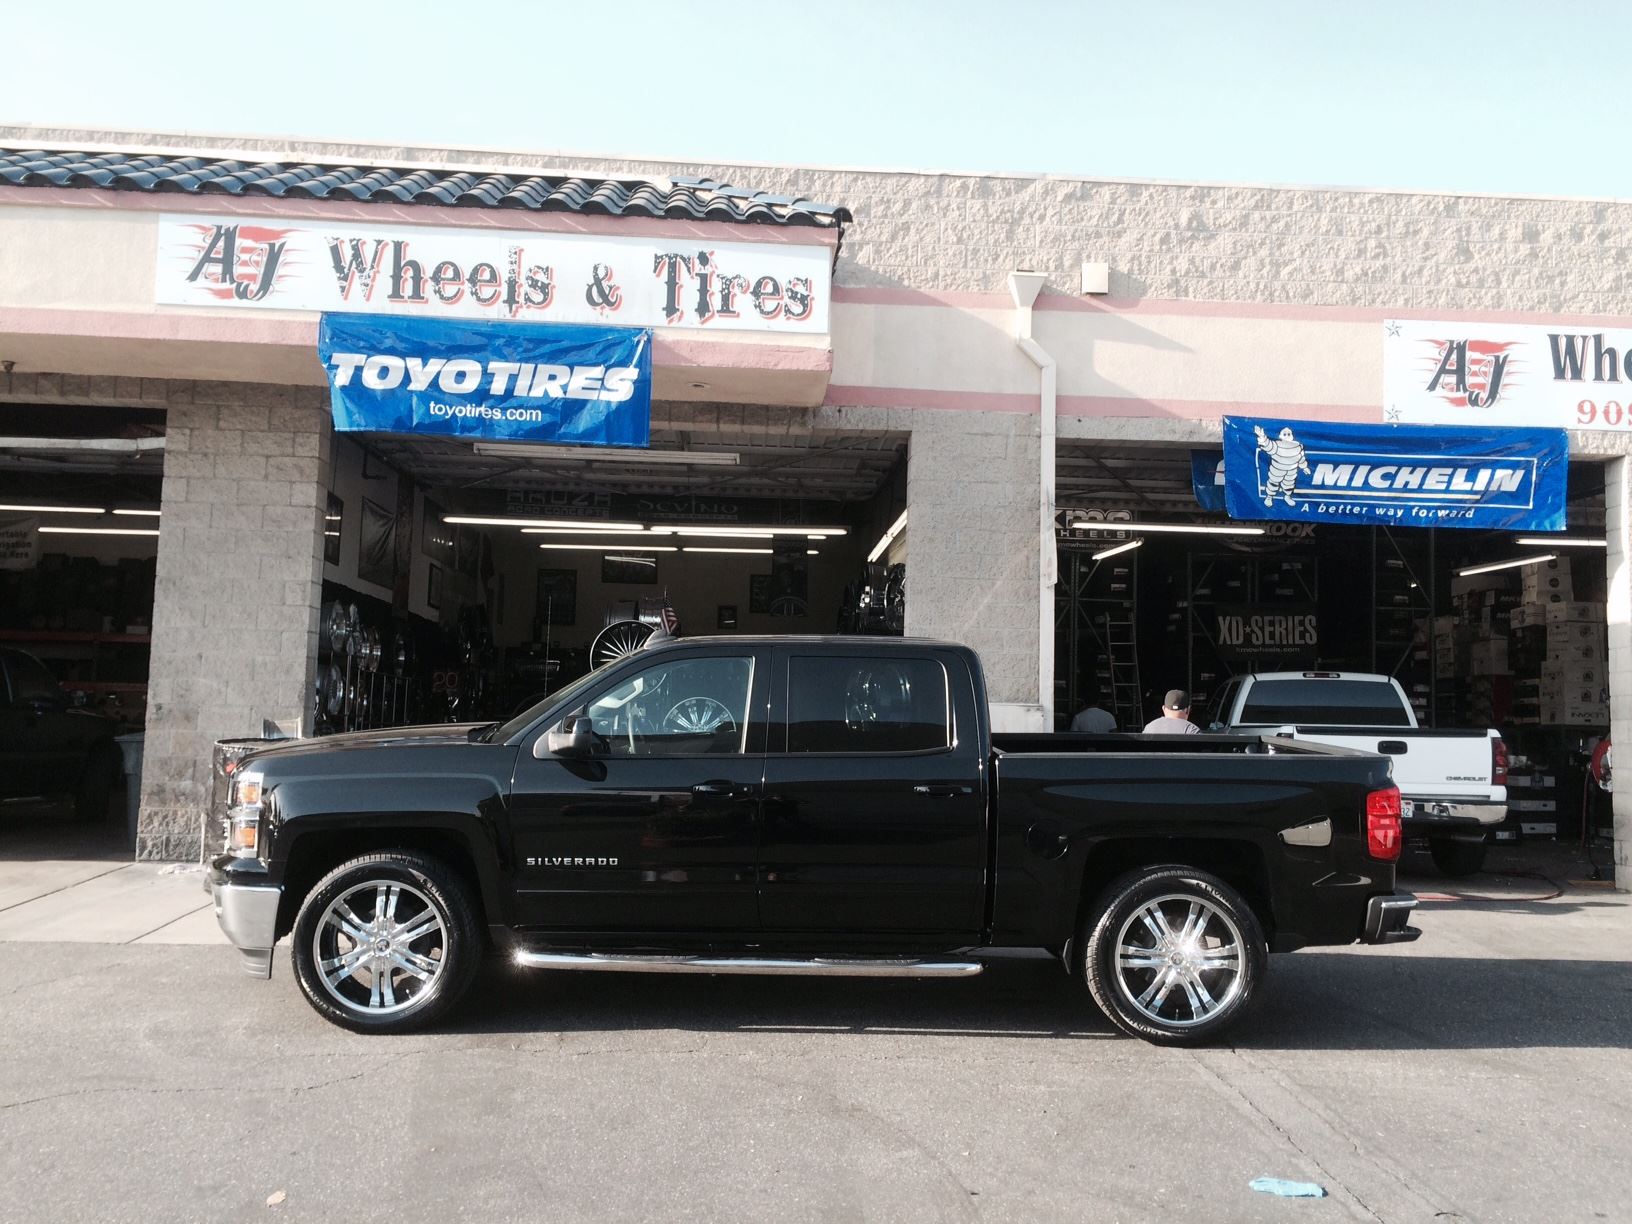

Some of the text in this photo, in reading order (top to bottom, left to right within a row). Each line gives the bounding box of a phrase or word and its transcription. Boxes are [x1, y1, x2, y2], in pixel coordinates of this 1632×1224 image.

[185, 223, 814, 326] AJ Wheels & Tires
[328, 352, 641, 403] TOYO TIRES
[1427, 338, 1510, 408] AJ
[429, 401, 543, 424] toyotires.com
[1577, 400, 1632, 426] 90
[1311, 463, 1526, 493] MICHELIN
[1301, 503, 1475, 519] A better way forward
[1060, 529, 1126, 539] HEELS
[526, 857, 619, 866] SILVERADO
